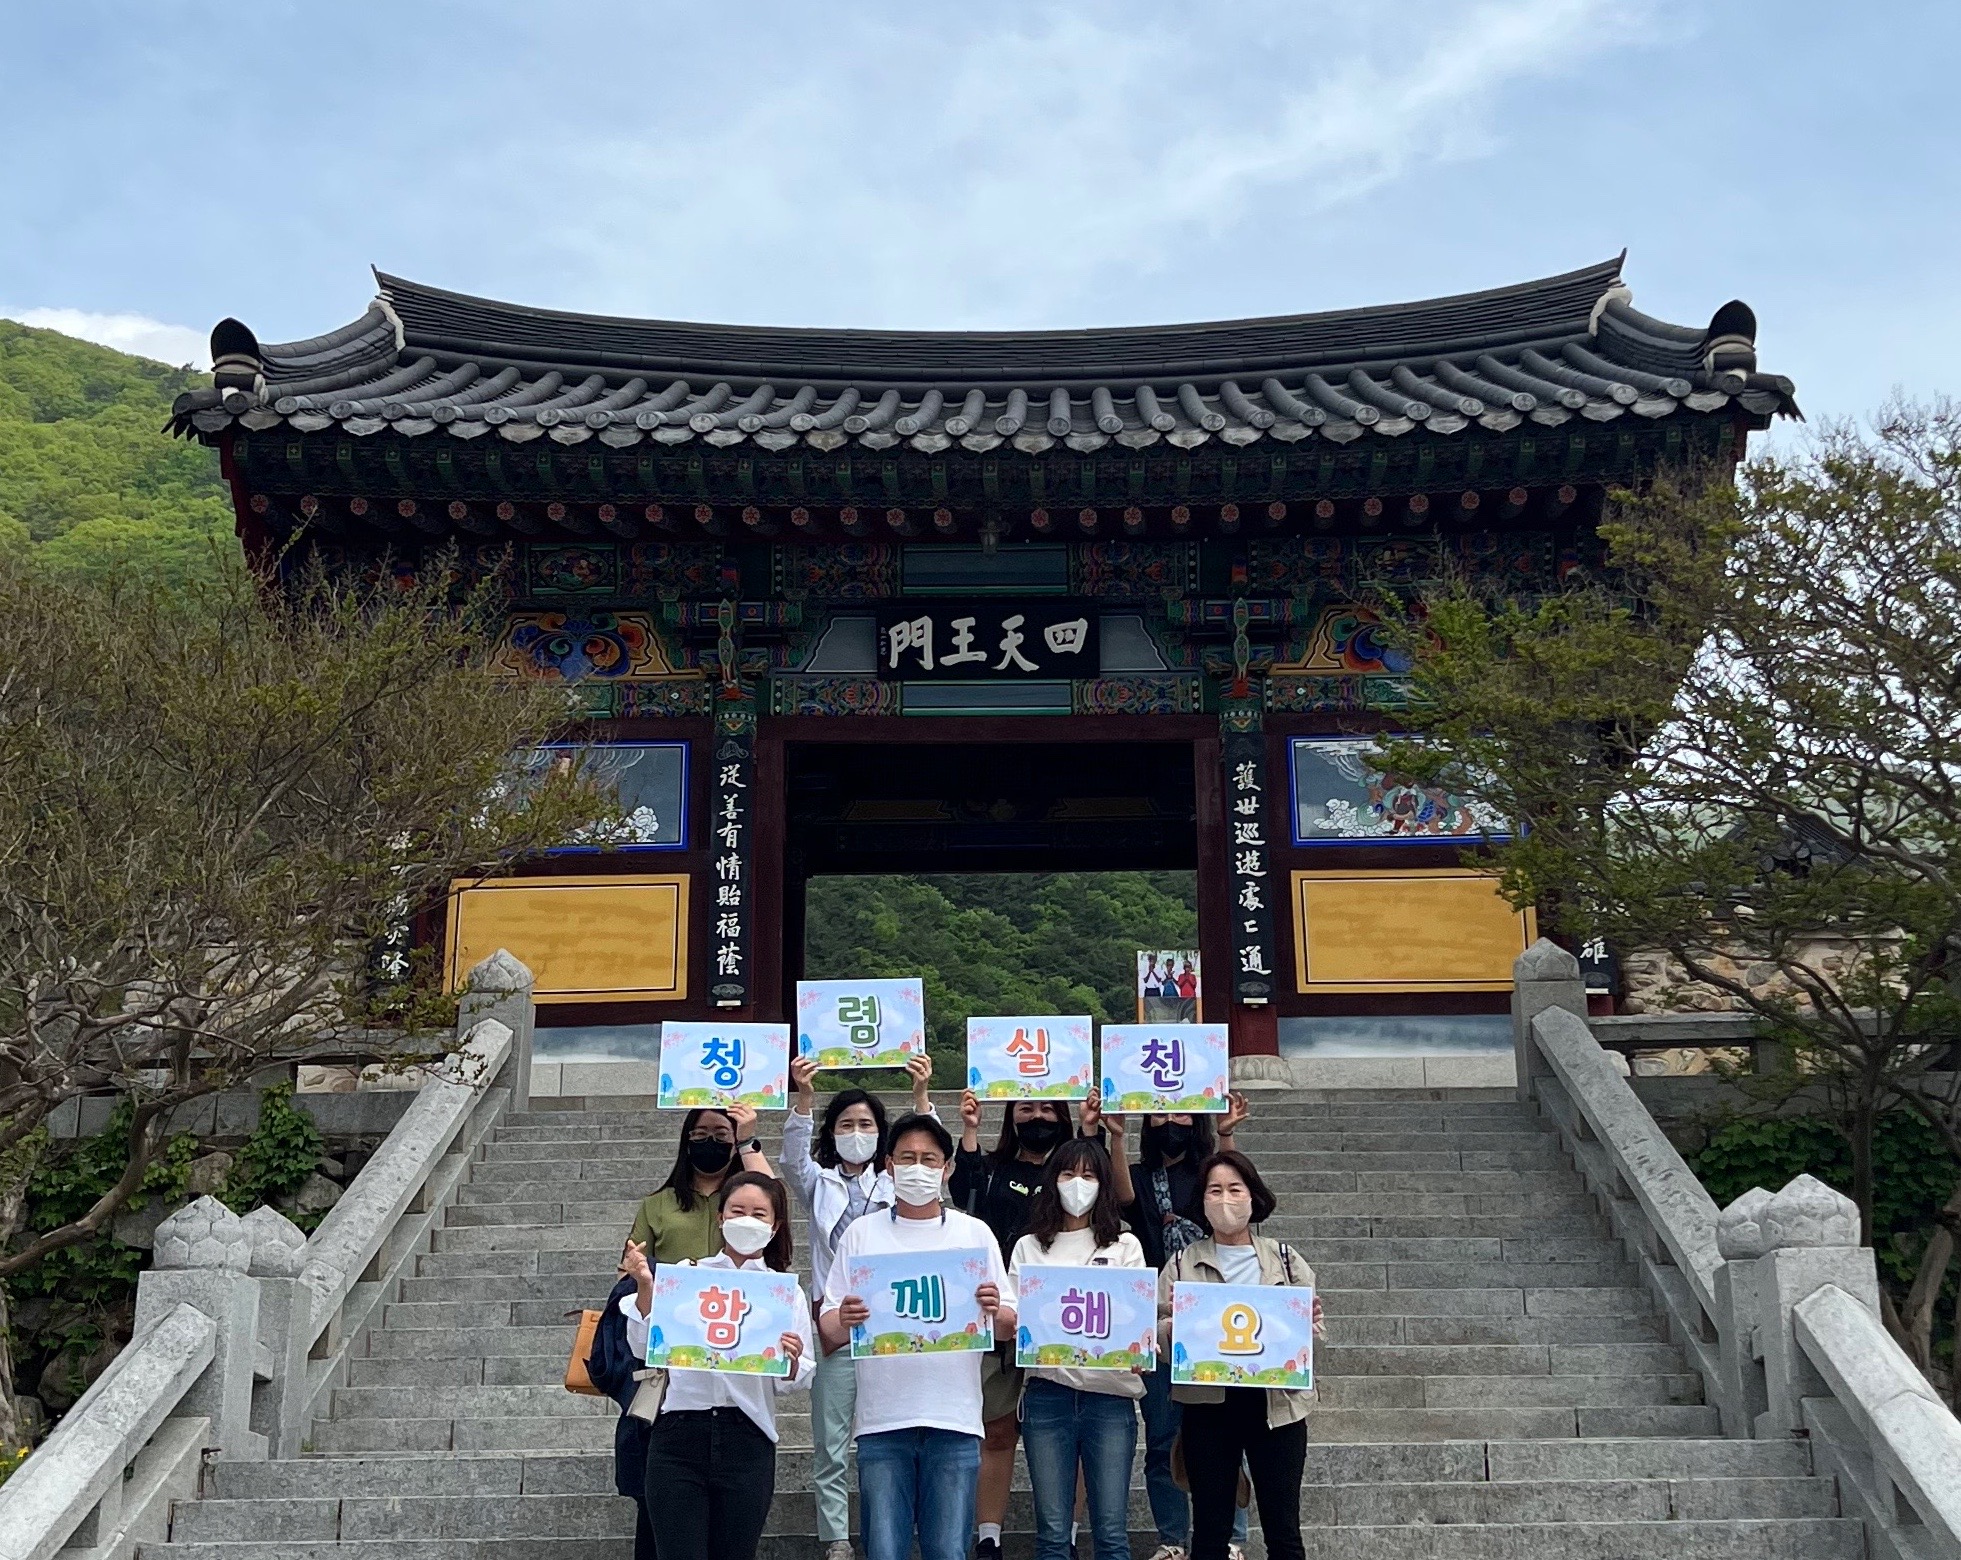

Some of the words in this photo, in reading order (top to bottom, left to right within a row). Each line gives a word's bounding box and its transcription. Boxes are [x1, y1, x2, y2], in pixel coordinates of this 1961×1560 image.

[837, 993, 881, 1047] 렴
[700, 1036, 744, 1090] 청
[1005, 1026, 1050, 1076] 실
[1140, 1037, 1187, 1092] 천
[697, 1284, 751, 1349] 함
[889, 1273, 945, 1323] 께
[1059, 1285, 1109, 1339] 해
[1217, 1304, 1263, 1355] 요
